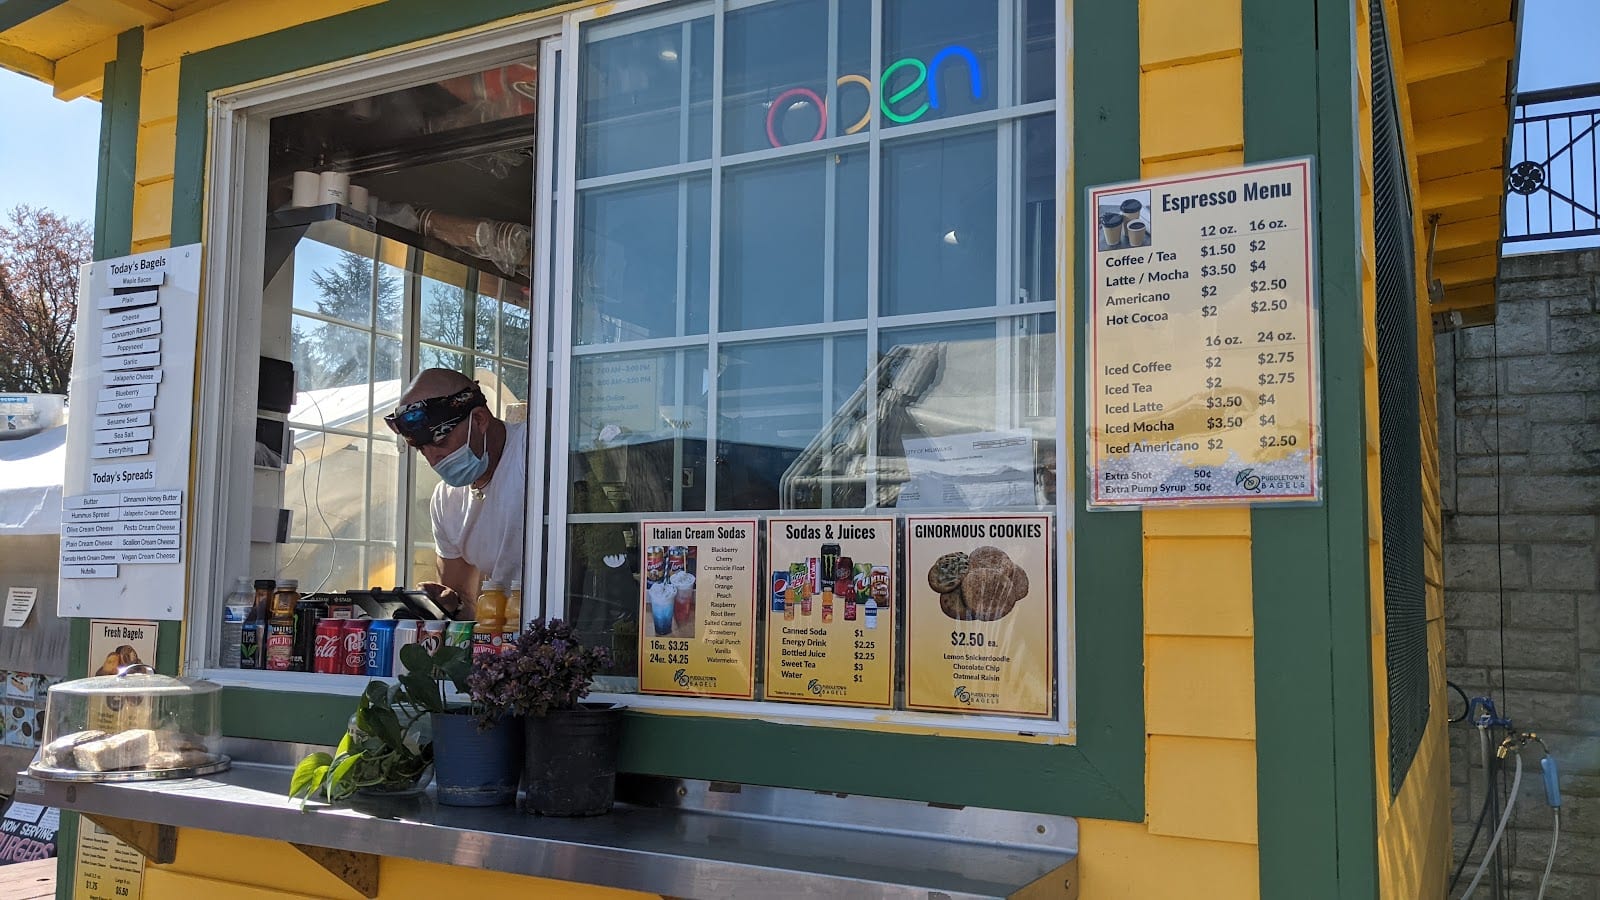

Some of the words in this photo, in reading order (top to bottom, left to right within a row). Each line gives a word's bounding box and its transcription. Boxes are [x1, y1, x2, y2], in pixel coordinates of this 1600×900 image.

[766, 45, 981, 148] open
[1162, 189, 1237, 213] Espresso
[1243, 182, 1292, 201] Menu
[1250, 219, 1266, 231] 16
[1269, 219, 1287, 230] oz.
[1200, 225, 1216, 237] 12
[1219, 225, 1237, 236] oz.
[1200, 243, 1236, 258] $1.50
[1249, 240, 1266, 252] $2
[1105, 255, 1145, 268] Coffee
[1156, 250, 1177, 262] Tea
[110, 262, 139, 275] Today's
[140, 256, 166, 271] Bagels
[1200, 263, 1236, 278] $3.50
[1250, 259, 1266, 273] $4
[1106, 274, 1136, 287] Latte
[1148, 269, 1189, 283] Mocha
[1250, 278, 1287, 293] $2.50
[1201, 285, 1217, 298] $2
[1105, 291, 1170, 307] Americano
[1201, 305, 1217, 318] $2
[1250, 299, 1287, 314] $2.50
[121, 313, 140, 322] Cheese
[1106, 313, 1129, 326] Hot
[1131, 312, 1169, 324] Cocoa
[111, 330, 135, 340] Cinnamon
[136, 326, 151, 336] Raisin
[1257, 331, 1274, 343] 24
[1277, 331, 1296, 341] oz.
[1205, 336, 1221, 347] 16
[1224, 336, 1243, 346] oz.
[117, 343, 144, 352] Poppyseed
[123, 358, 138, 366] Garlic
[1205, 357, 1222, 369] $2
[1257, 352, 1295, 365] $2.75
[1104, 364, 1129, 376] Iced
[1132, 361, 1172, 373] Coffee
[136, 373, 154, 381] Cheese
[1258, 372, 1295, 385] $2.75
[1104, 384, 1129, 395] Iced
[1132, 382, 1153, 393] Tea
[1206, 377, 1222, 389] $2
[115, 389, 140, 398] Blueberry
[1206, 396, 1243, 409] $3.50
[1258, 393, 1275, 406] $4
[117, 401, 133, 410] Onion
[1105, 403, 1129, 414] Iced
[1133, 402, 1164, 413] Latte
[106, 418, 126, 427] Sesame
[1206, 417, 1243, 430] $3.50
[1259, 414, 1276, 426] $4
[1105, 423, 1130, 434] Iced
[1133, 421, 1175, 432] Mocha
[113, 432, 124, 440] Sea
[124, 430, 134, 439] Salt
[1207, 438, 1223, 450] $2
[1259, 435, 1297, 448] $2.50
[108, 445, 134, 455] Everything
[1105, 443, 1130, 454] Iced
[1133, 441, 1200, 453] Americano
[92, 472, 121, 485] Today's
[122, 469, 153, 484] Spreads
[1105, 472, 1129, 481] Extra
[1131, 471, 1152, 480] Shot
[1194, 469, 1211, 479] 50¢
[1261, 474, 1305, 482] PUDDLETOWN
[1105, 485, 1129, 494] Extra
[1131, 484, 1158, 495] Pump
[1160, 483, 1186, 493] Syrup
[1194, 483, 1211, 492] 50¢
[1261, 481, 1305, 489] BAGELS
[83, 498, 99, 506] Butter
[123, 495, 147, 503] Cinnamon
[147, 494, 162, 503] Honey
[162, 493, 178, 501] Butter
[92, 510, 110, 519] Spread
[156, 523, 176, 531] Cheese
[786, 525, 821, 539] Sodas
[825, 524, 834, 539] &
[838, 524, 876, 540] Juices
[915, 524, 985, 538] GINORMOUS
[989, 524, 1041, 538] COOKIES
[653, 527, 682, 540] Italian
[685, 527, 715, 540] Cream
[717, 526, 746, 539] Sodas
[79, 539, 95, 547] Cream
[711, 546, 738, 554] Blackberry
[121, 553, 137, 561] Vegan
[156, 552, 176, 560] Cheese
[715, 555, 733, 563] Cherry
[715, 574, 733, 582] Mango
[710, 601, 737, 609] Raspberry
[704, 619, 721, 627] Salted
[104, 626, 121, 638] Fresh
[122, 627, 144, 640] Bagels
[708, 629, 737, 637] Strawberry
[782, 627, 808, 636] Canned
[809, 627, 827, 636] Soda
[854, 629, 864, 638] $1
[704, 638, 724, 646] Tropical
[782, 638, 806, 647] Energy
[807, 638, 827, 647] Drink
[951, 631, 984, 647] $2.50
[987, 639, 998, 648] ea.
[369, 632, 379, 668] pepsi
[668, 640, 689, 651] $3.25
[714, 647, 731, 655] Vanilla
[854, 641, 875, 650] $2.25
[668, 653, 689, 665] $4.25
[781, 649, 807, 657] Bottled
[808, 650, 826, 658] Juice
[854, 652, 875, 661] $2.25
[943, 653, 965, 661] Lemon
[965, 653, 1010, 663] Snickerdoodle
[707, 656, 738, 665] Watermelon
[781, 660, 803, 668] Sweet
[804, 660, 816, 669] Tea
[854, 663, 864, 672] $3
[952, 663, 985, 671] Chocolate
[985, 664, 1000, 673] Chip
[781, 671, 803, 679] Water
[853, 674, 863, 683] $1
[953, 673, 980, 681] Oatmeal
[980, 674, 1000, 682] Raisin
[0, 819, 21, 832] NOW
[20, 823, 55, 841] SERVING
